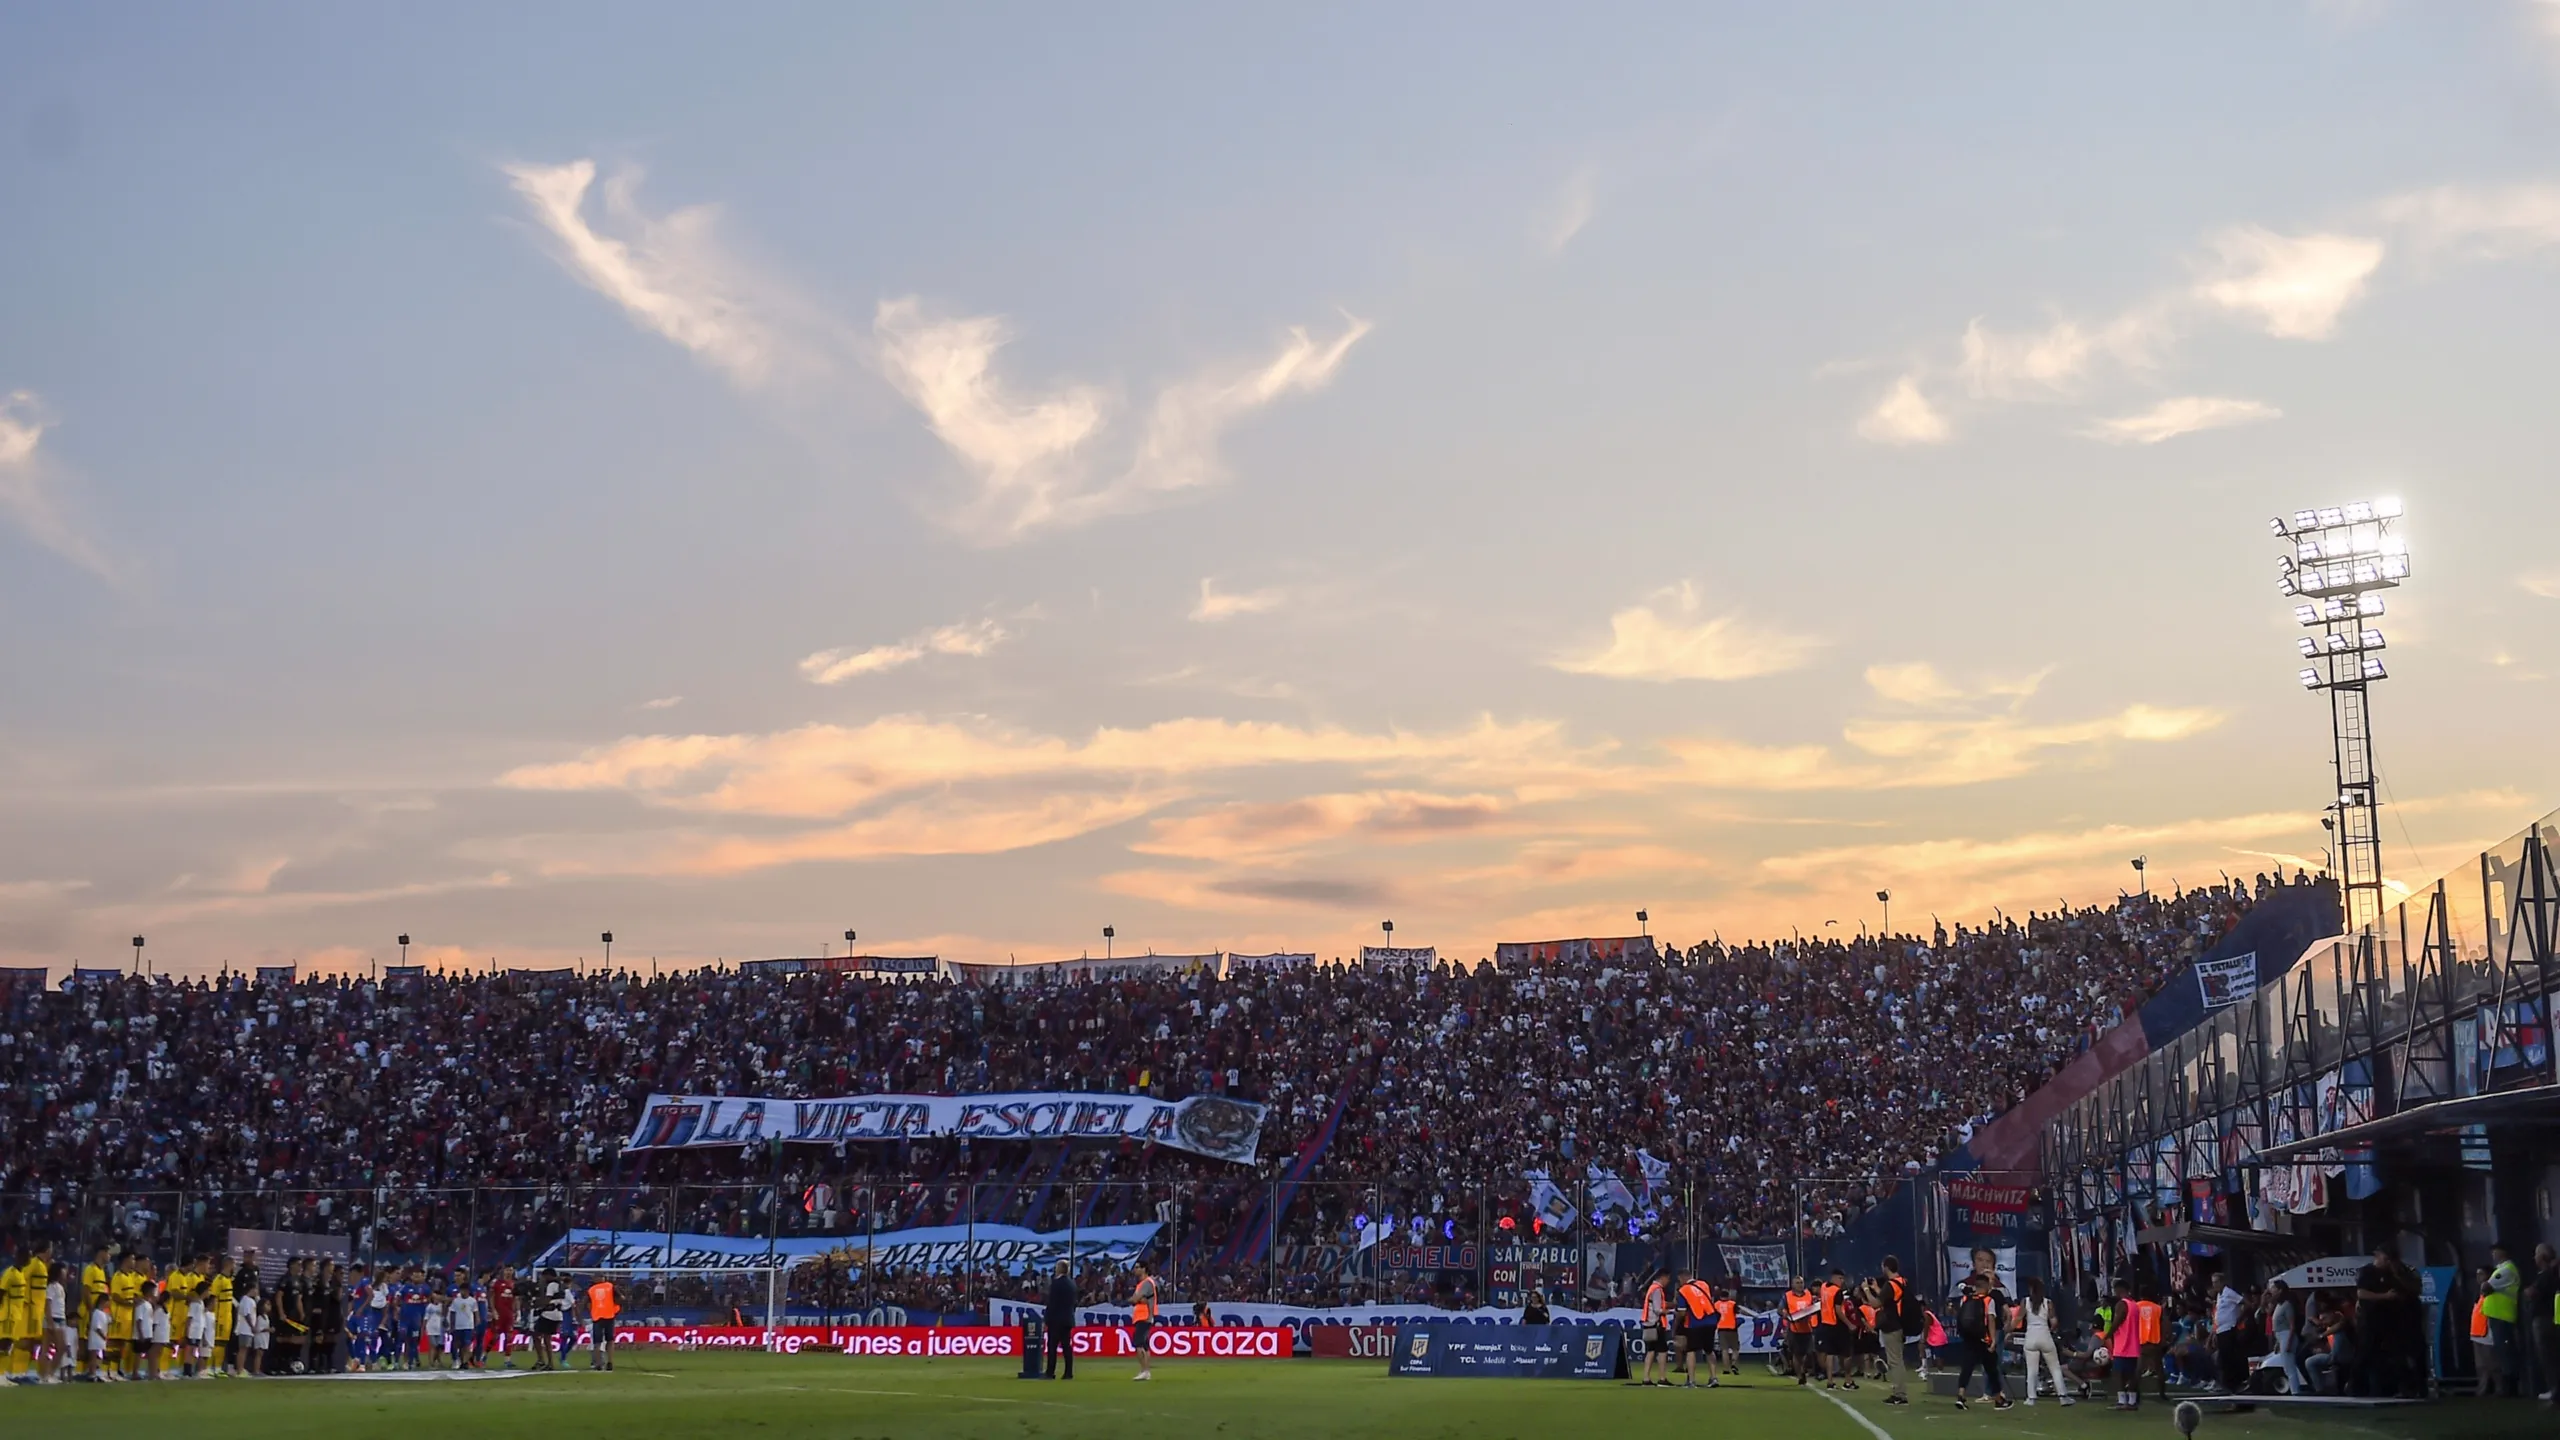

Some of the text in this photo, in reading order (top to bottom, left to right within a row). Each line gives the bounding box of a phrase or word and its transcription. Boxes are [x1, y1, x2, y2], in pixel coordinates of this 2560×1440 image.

[693, 1100, 1176, 1140] LA VIEJA ESCUELA
[1952, 1184, 2026, 1204] MASCHWITZ
[1956, 1208, 2018, 1228] TE ALIENTA
[877, 1240, 1043, 1266] MATADOR
[1371, 1245, 1478, 1269] POMELO
[1495, 1247, 1579, 1264] SAN PABLO
[1493, 1270, 1516, 1283] CON
[832, 1330, 902, 1354] lunes
[907, 1338, 922, 1355] a
[927, 1330, 1012, 1356] jueves
